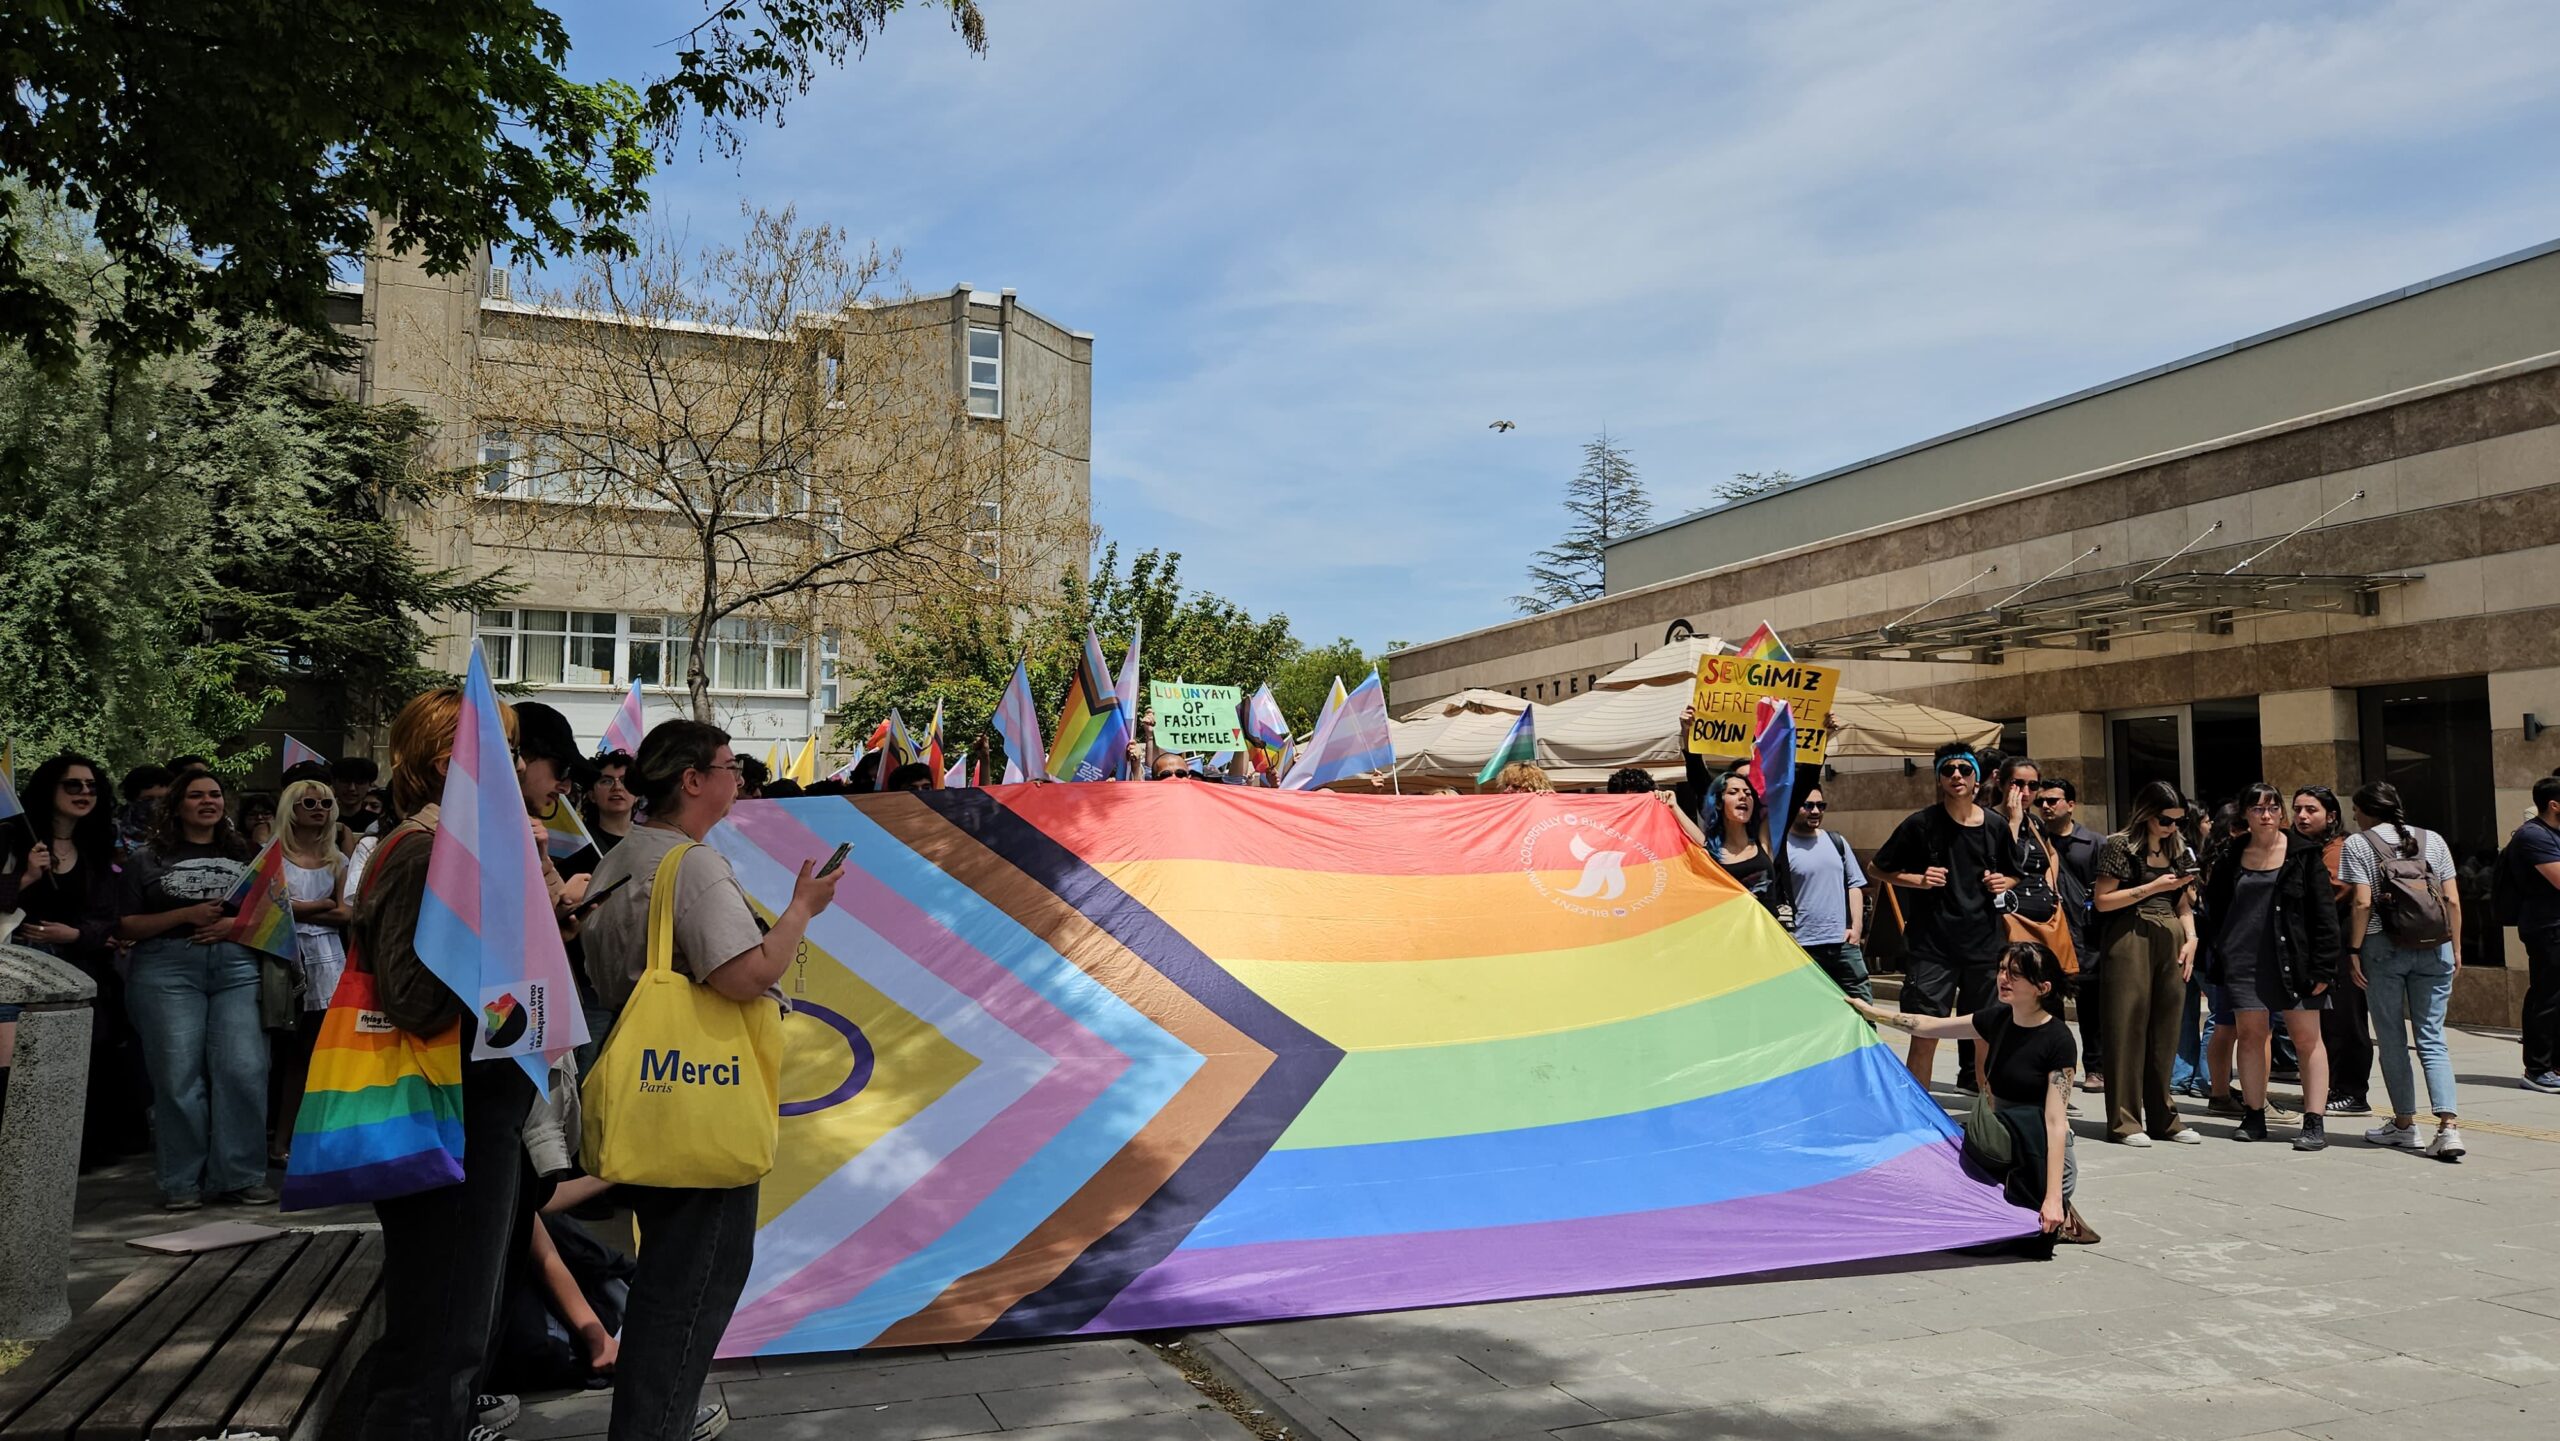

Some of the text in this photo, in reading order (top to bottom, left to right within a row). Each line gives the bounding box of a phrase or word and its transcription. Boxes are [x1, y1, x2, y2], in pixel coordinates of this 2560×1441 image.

[1169, 728, 1241, 746] TEKMELE!
[1693, 718, 1746, 743] BOYUN
[1520, 815, 1561, 865] COLORFULLY
[1581, 817, 1633, 843] BILKENT
[1633, 842, 1661, 864] THINK
[1523, 867, 1550, 897] THINK
[640, 1049, 740, 1085] Merci
[639, 1081, 673, 1093] Paris
